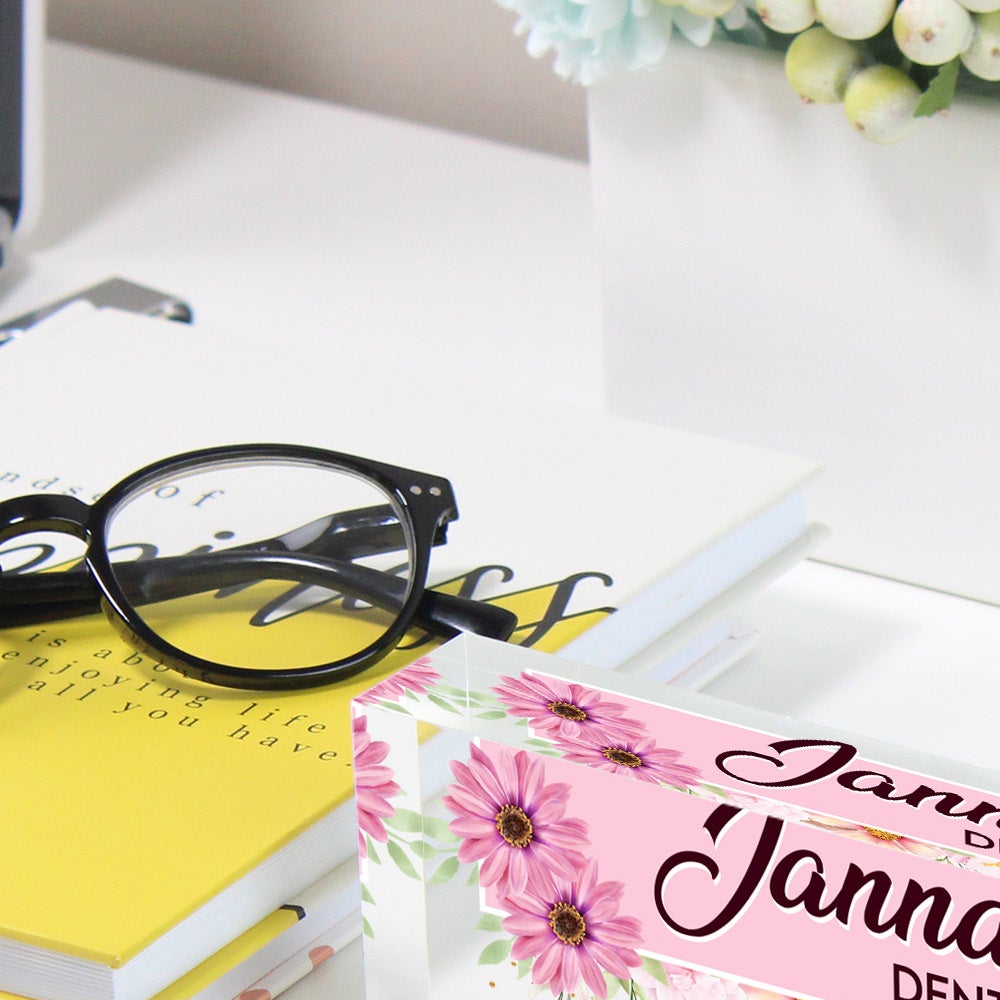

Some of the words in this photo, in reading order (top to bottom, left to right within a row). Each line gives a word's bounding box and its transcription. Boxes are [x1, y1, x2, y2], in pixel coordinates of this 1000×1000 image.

[154, 485, 225, 508] of
[27, 629, 67, 648] is
[1, 650, 212, 709] enjoying
[238, 702, 327, 734] life
[27, 679, 97, 701] all
[112, 701, 199, 728] you
[227, 724, 352, 767] have.
